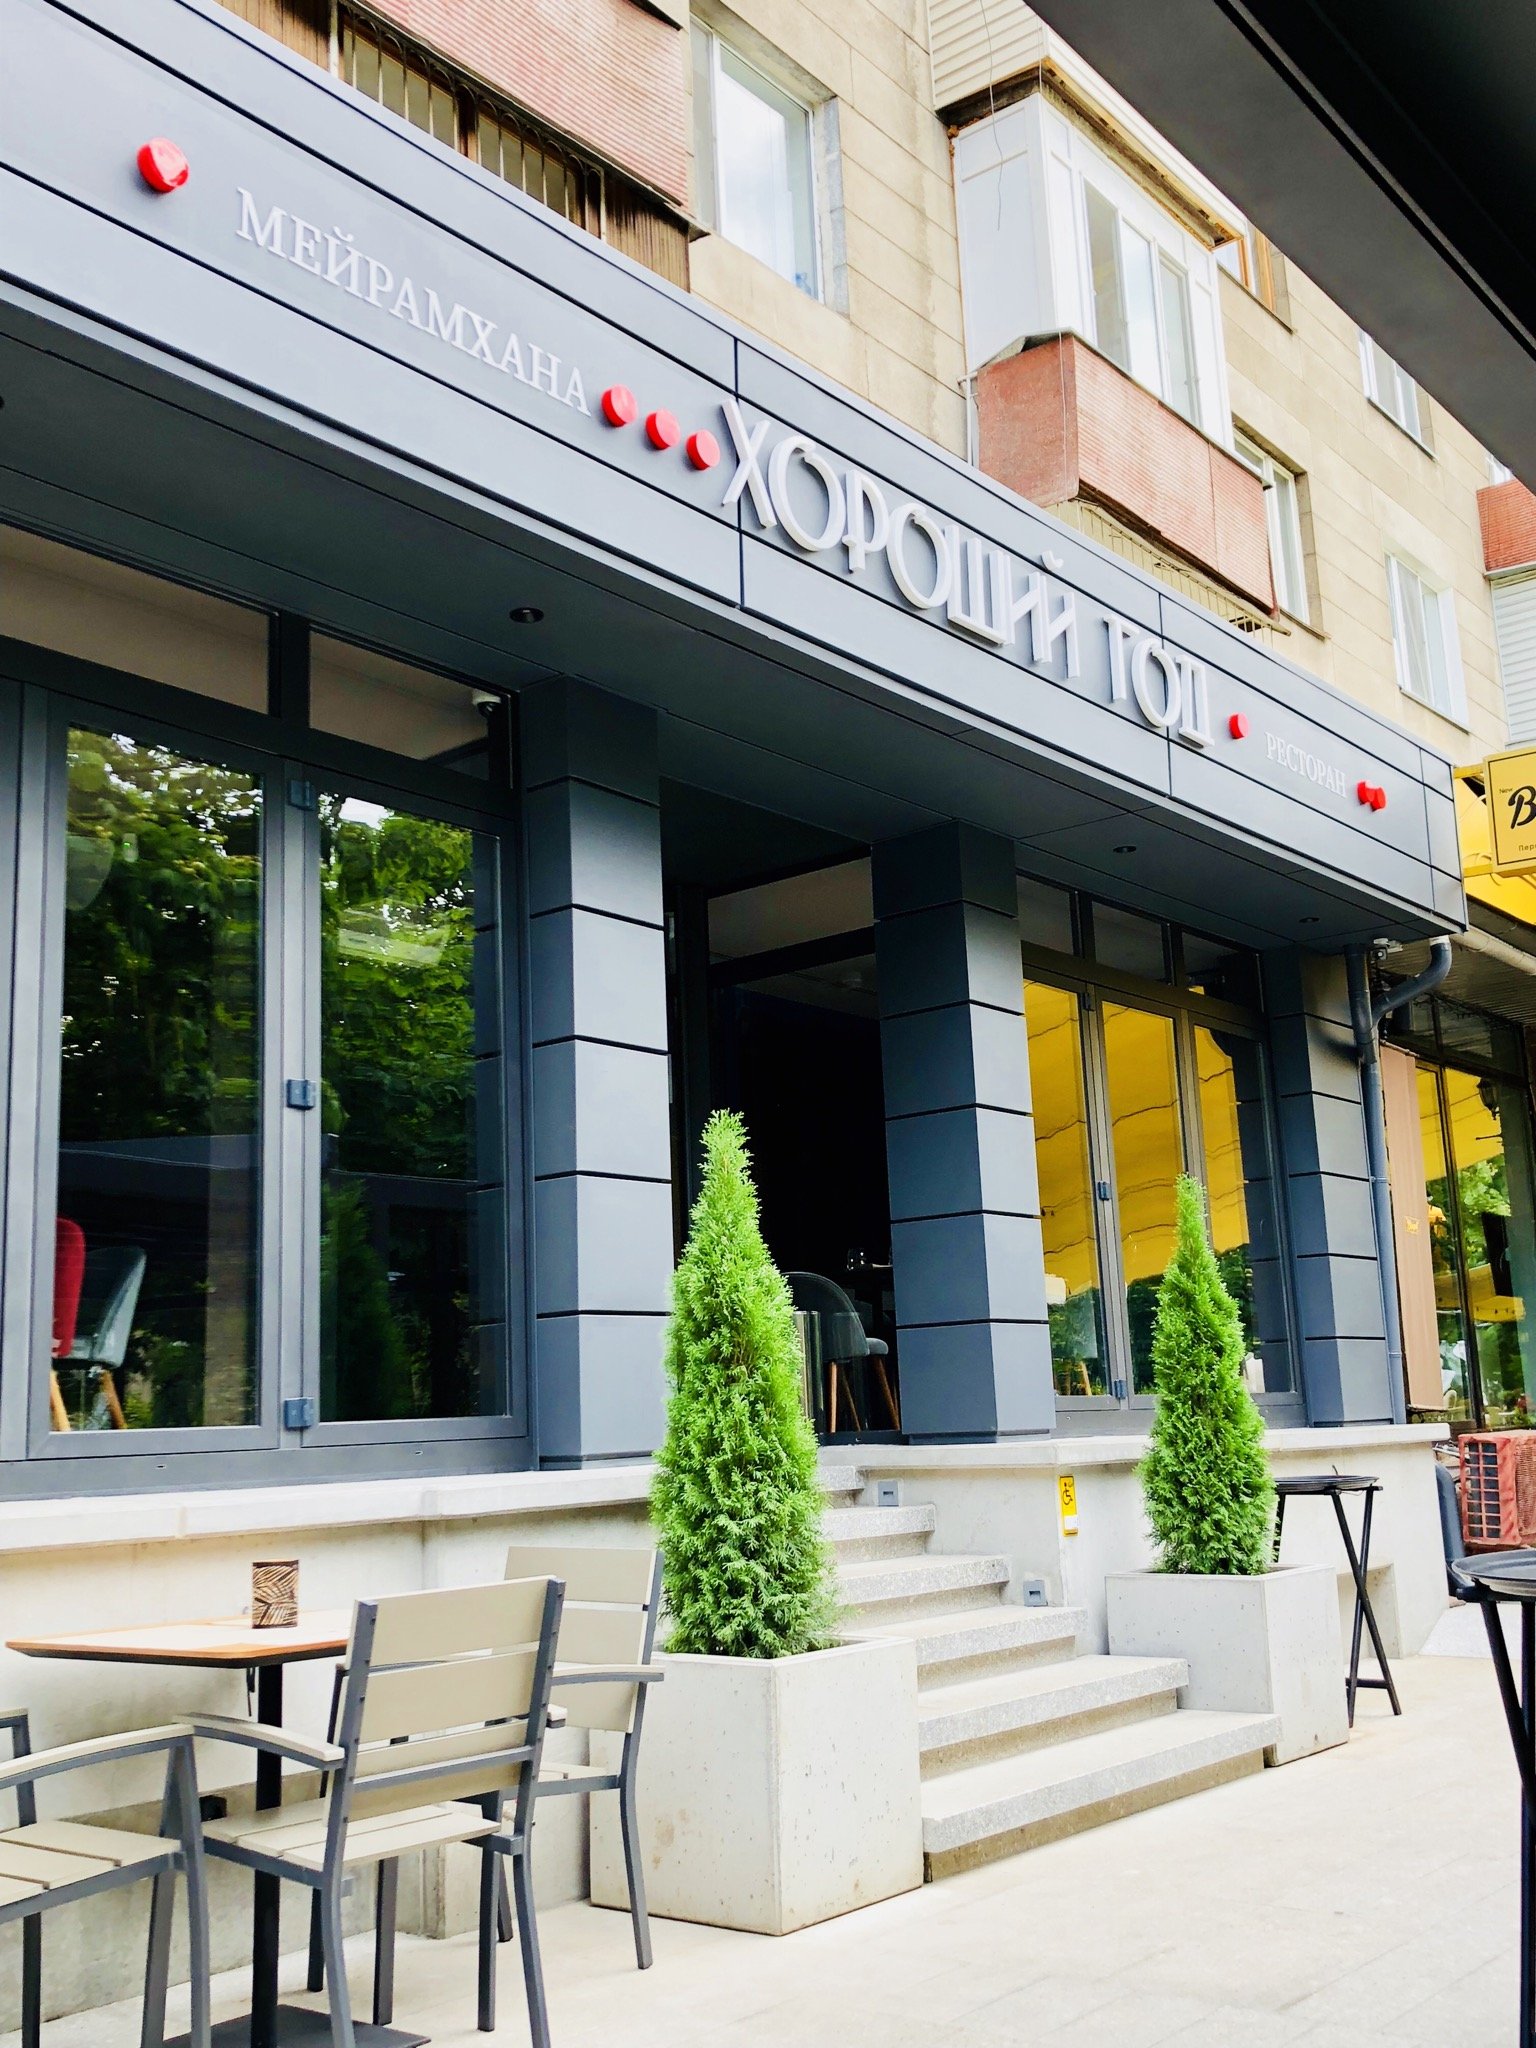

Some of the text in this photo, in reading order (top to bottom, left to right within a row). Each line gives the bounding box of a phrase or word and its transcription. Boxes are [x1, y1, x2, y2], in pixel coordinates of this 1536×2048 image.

[236, 186, 592, 418] МЕЙРАМХАНА
[721, 400, 1216, 748] ХОРОШИЙ ГОД
[1264, 731, 1348, 798] РЕСТОРАН
